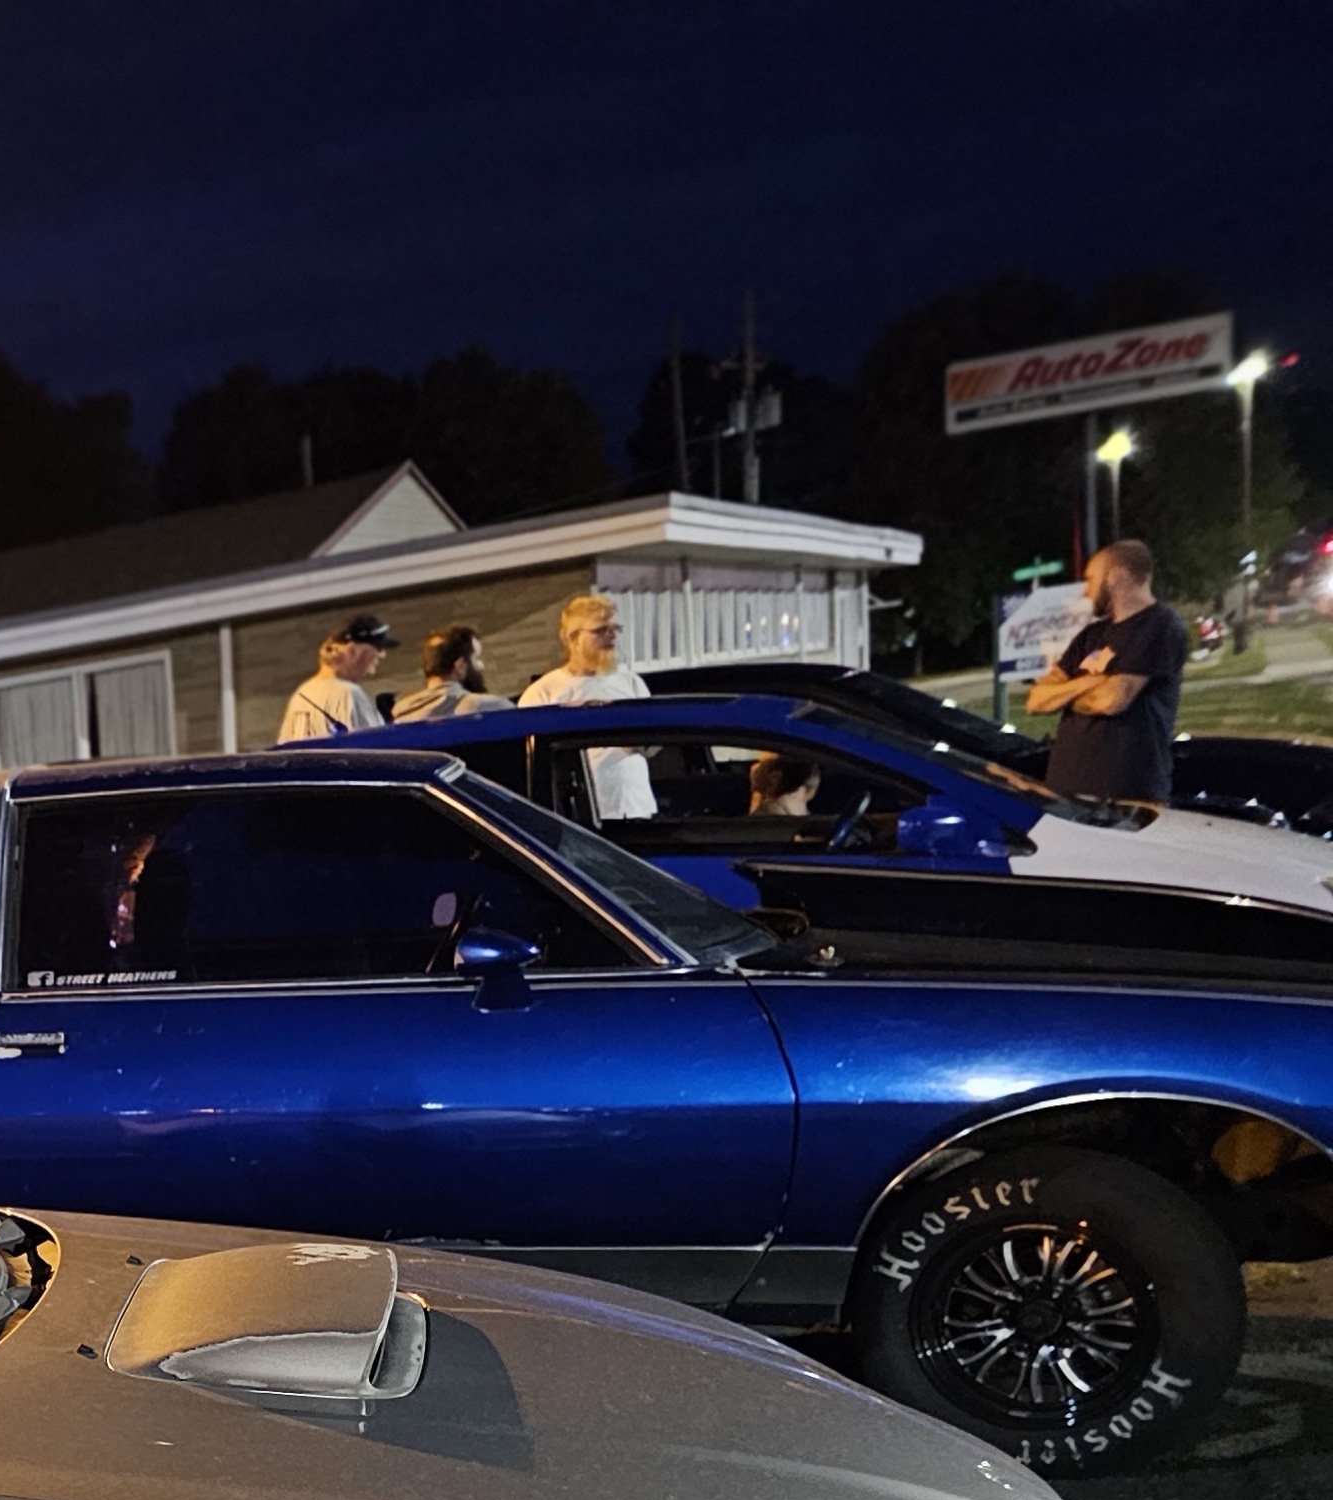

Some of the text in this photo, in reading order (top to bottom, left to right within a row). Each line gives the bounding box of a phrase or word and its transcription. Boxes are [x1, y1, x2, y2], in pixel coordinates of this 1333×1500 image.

[1009, 333, 1211, 391] AutoZone
[55, 973, 105, 986] STREET
[103, 969, 177, 984] HEATHENS
[873, 1177, 1040, 1293] Hoosier
